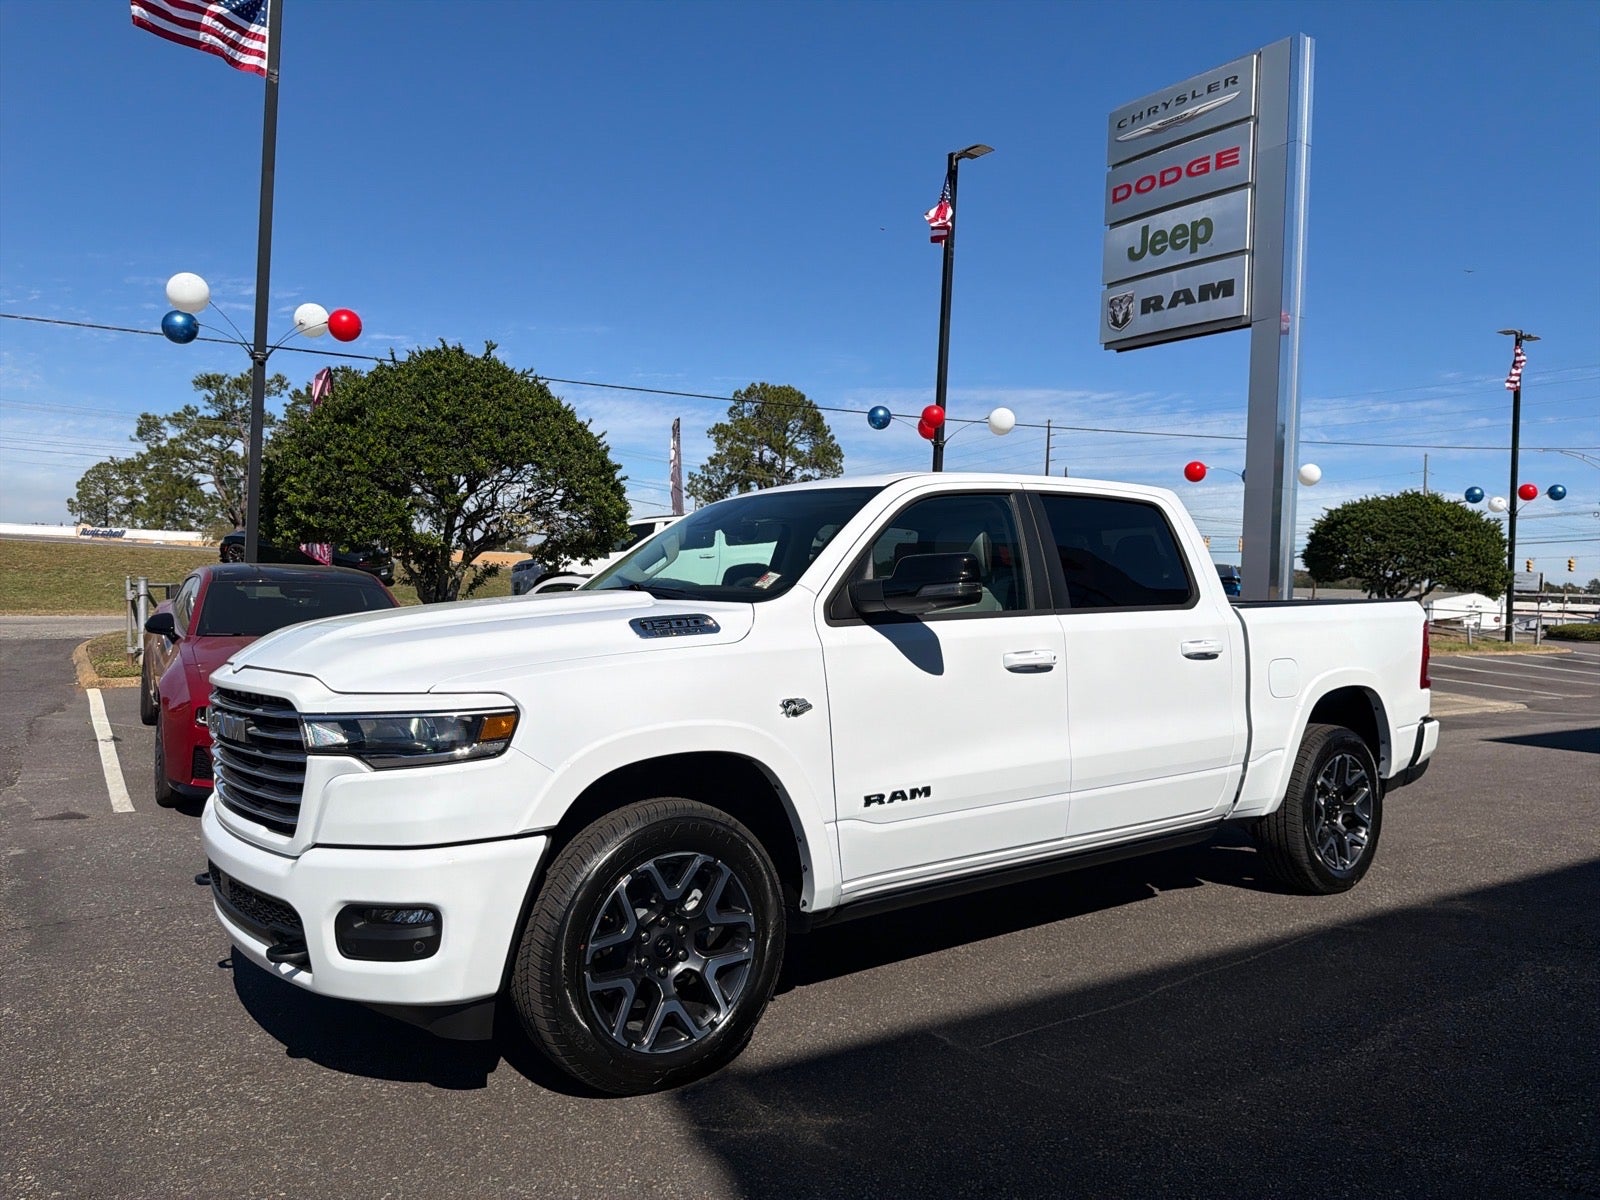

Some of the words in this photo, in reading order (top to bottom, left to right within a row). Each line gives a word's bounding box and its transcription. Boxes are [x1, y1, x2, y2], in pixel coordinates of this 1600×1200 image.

[1117, 75, 1239, 130] CHRYSLER
[1111, 146, 1241, 205] DODGE
[1127, 216, 1214, 262] Jeep
[1140, 278, 1235, 316] RAM
[640, 617, 706, 631] 1500
[863, 785, 932, 808] RAM
